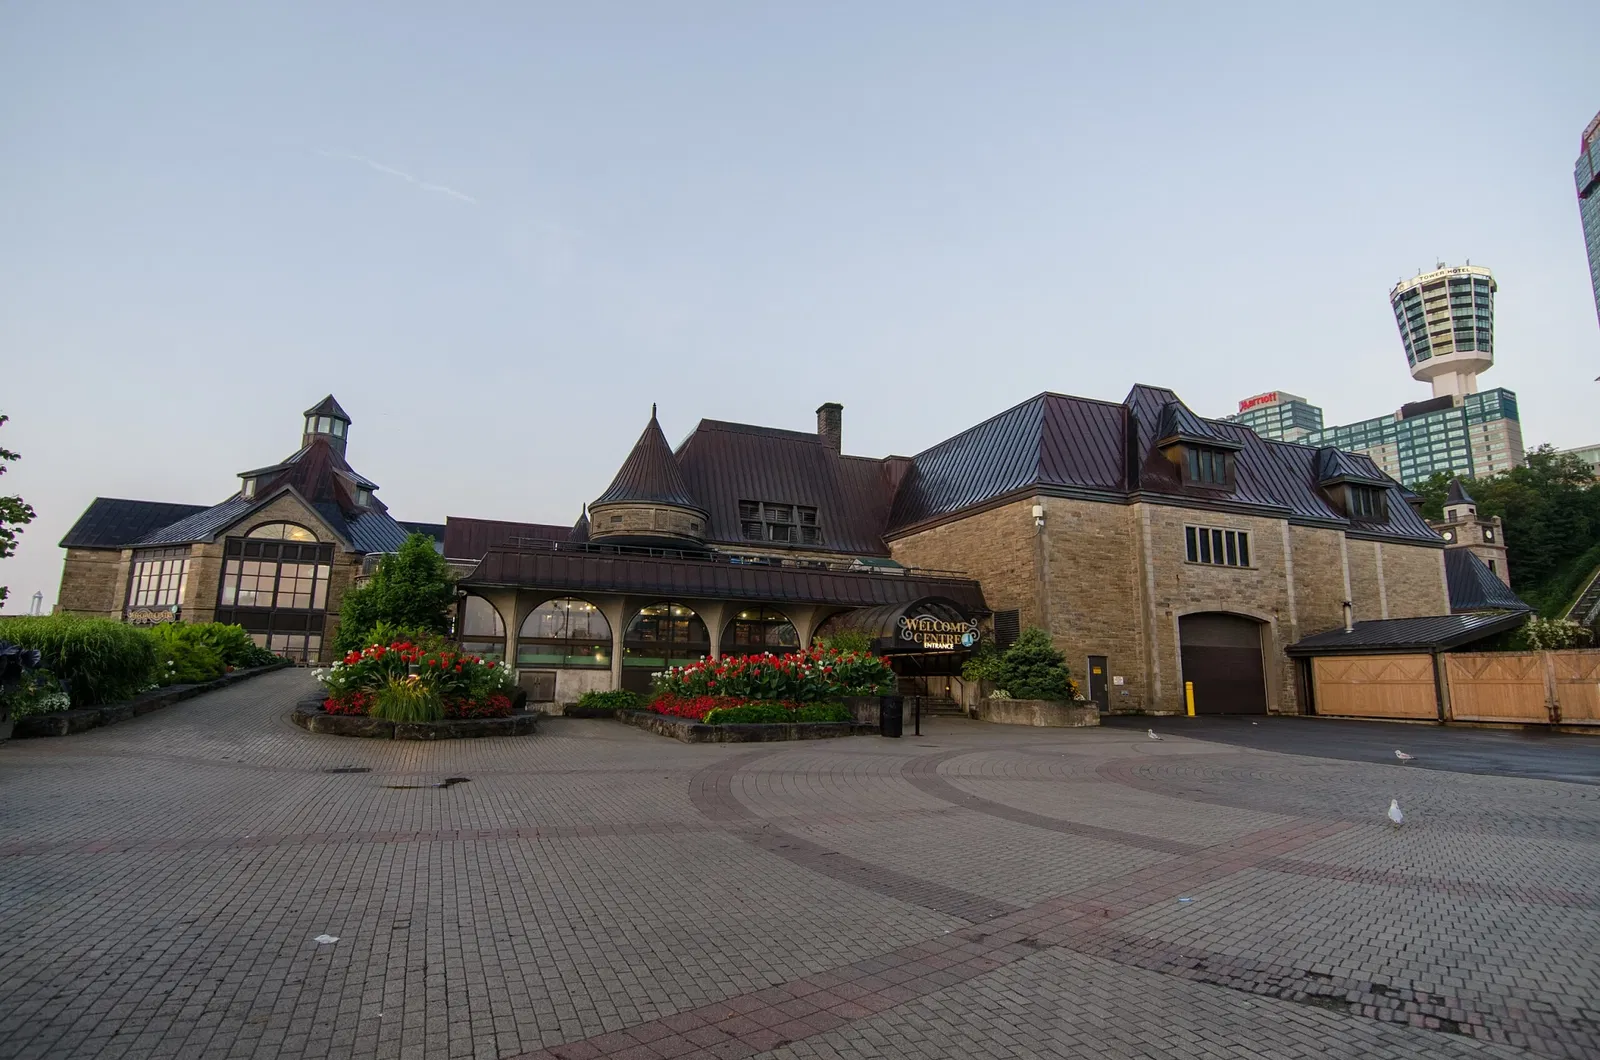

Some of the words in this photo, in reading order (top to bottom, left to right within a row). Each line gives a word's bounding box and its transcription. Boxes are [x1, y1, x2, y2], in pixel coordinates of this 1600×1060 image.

[1420, 271, 1445, 281] TOWER
[906, 618, 968, 633] WELCOME
[913, 633, 962, 645] CENTRE
